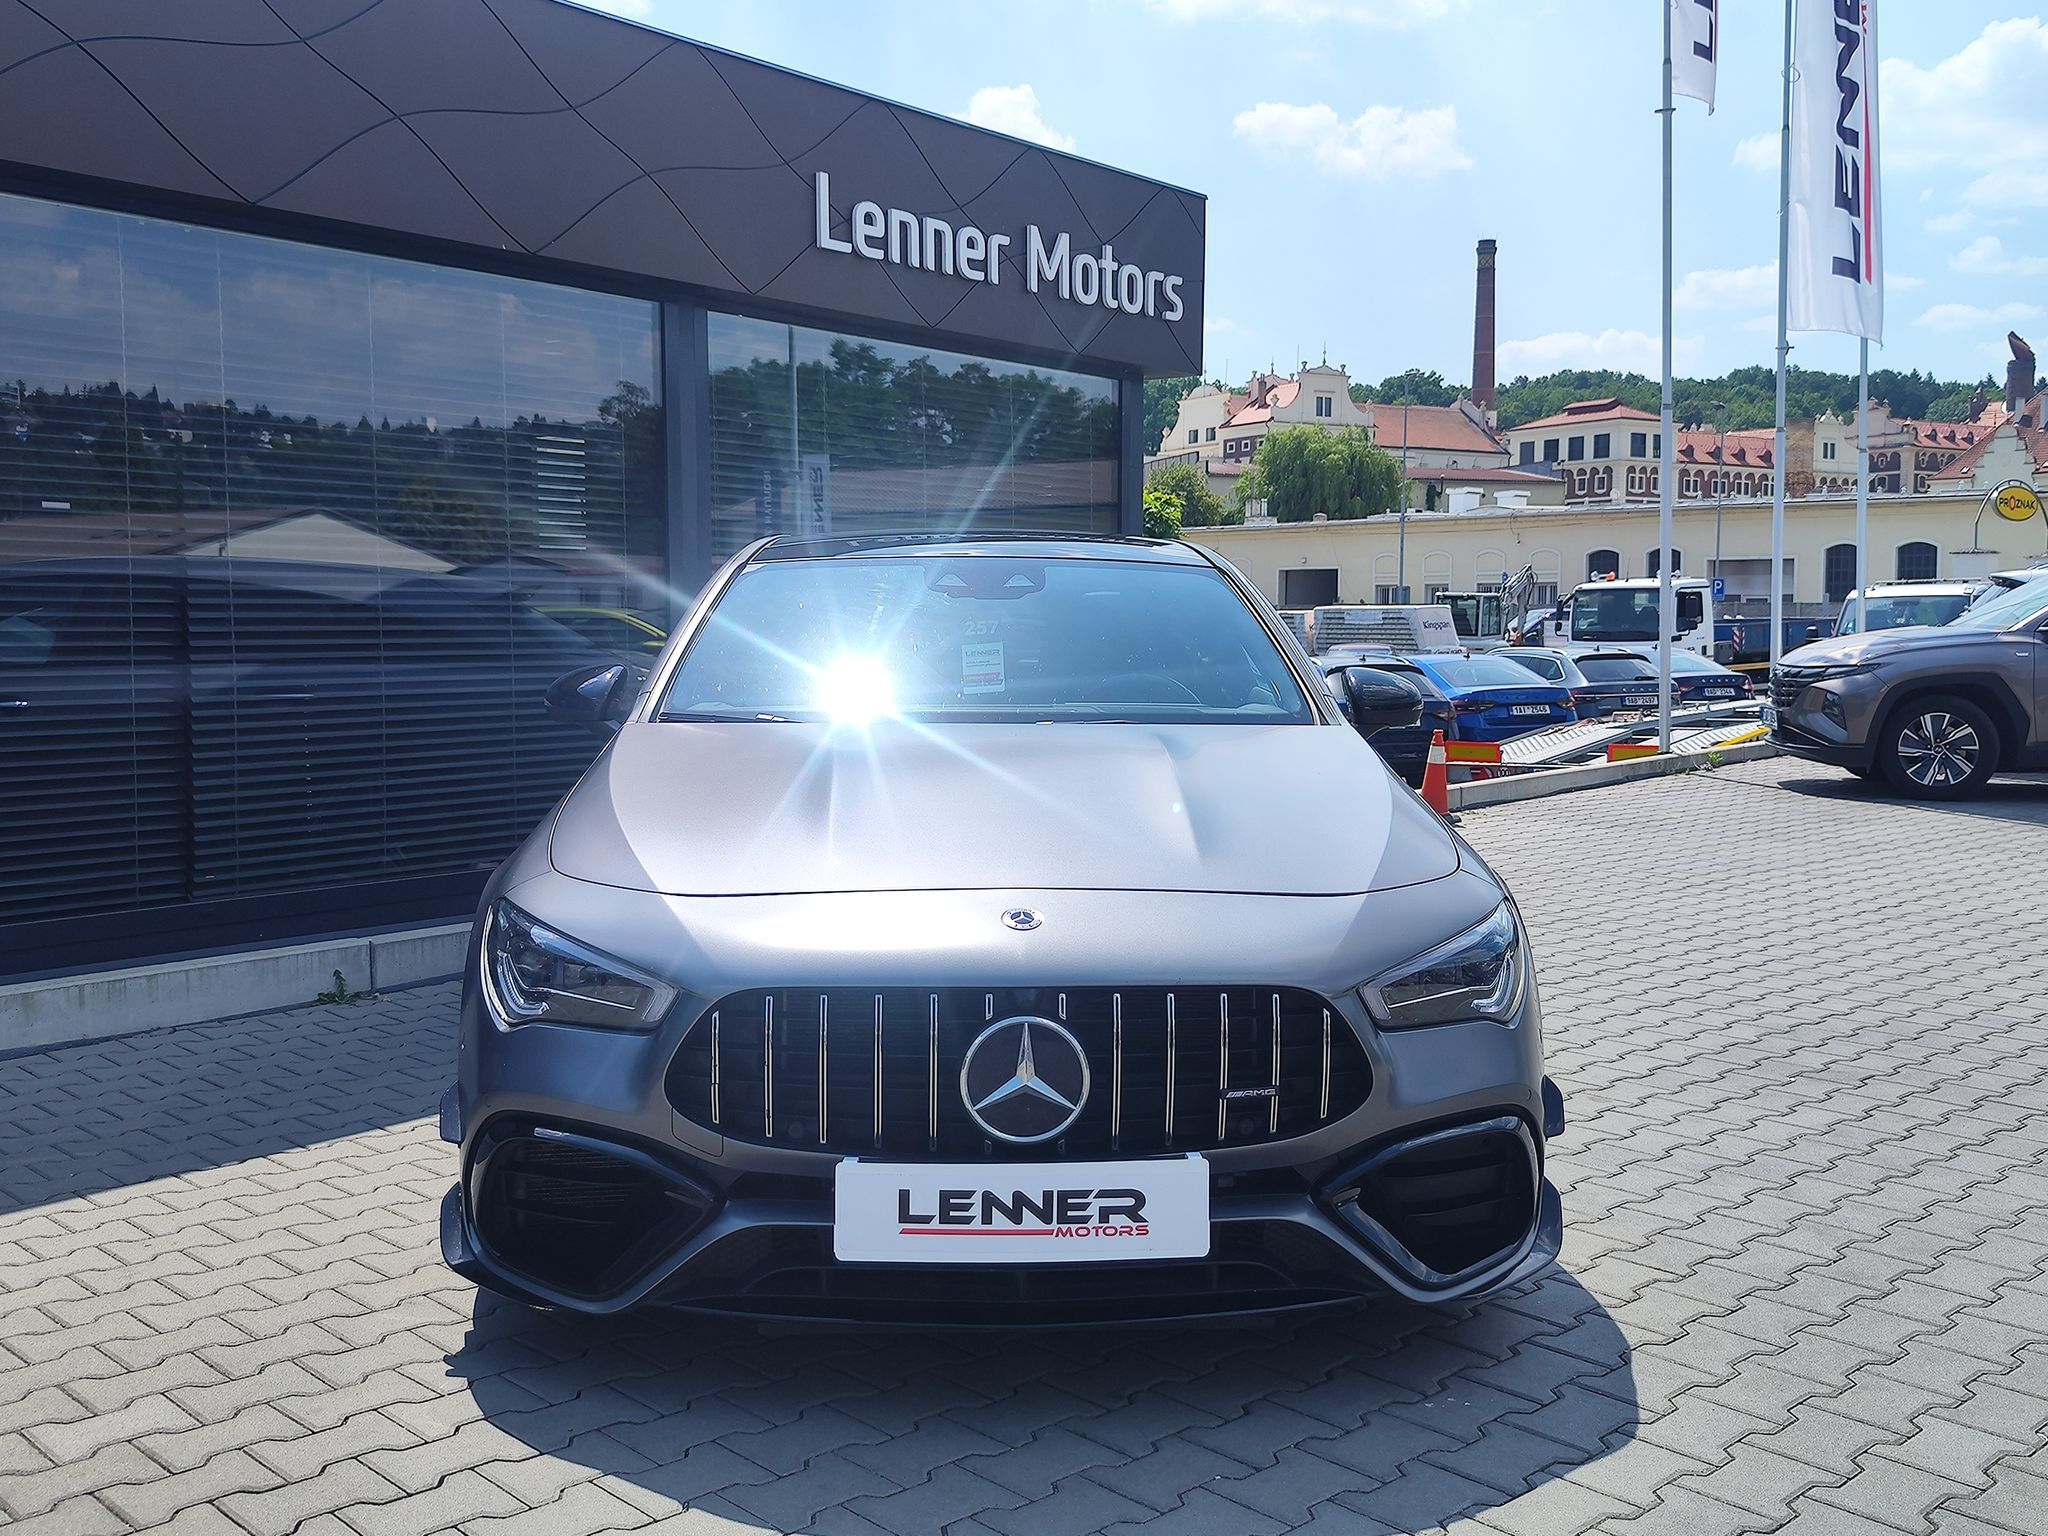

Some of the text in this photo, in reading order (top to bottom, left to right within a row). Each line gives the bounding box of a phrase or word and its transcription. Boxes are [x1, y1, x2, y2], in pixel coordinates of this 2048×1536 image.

[815, 171, 1184, 322] Lenner Motors
[1998, 496, 2036, 511] PROZNAK
[1714, 580, 1723, 594] P
[964, 620, 1000, 635] 257
[1242, 1088, 1276, 1097] AMG
[897, 1188, 1150, 1226] LENNER
[1053, 1223, 1151, 1239] MOTORS
